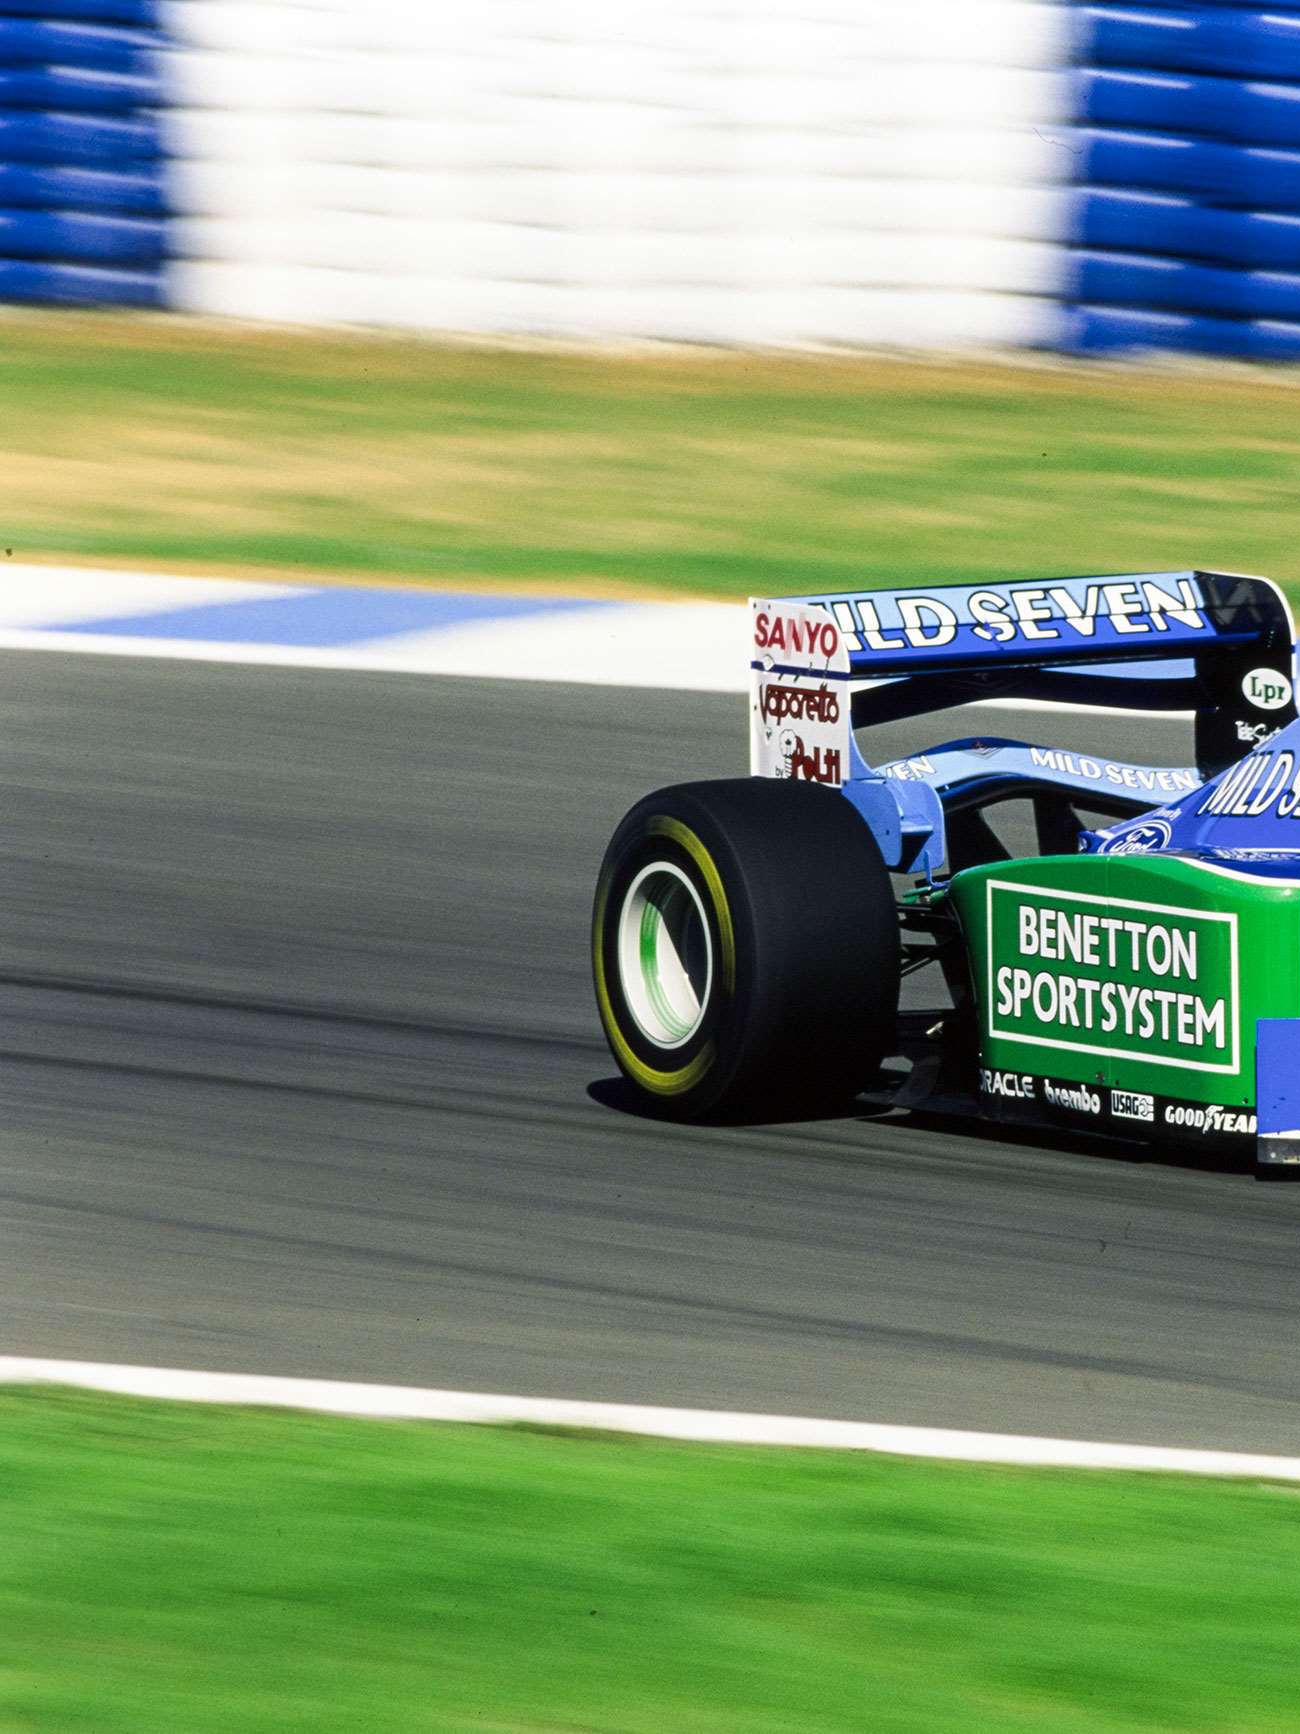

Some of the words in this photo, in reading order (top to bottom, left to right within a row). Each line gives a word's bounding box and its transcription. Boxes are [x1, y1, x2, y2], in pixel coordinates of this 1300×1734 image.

[754, 612, 838, 657] SANYO
[808, 596, 958, 652] ILD
[967, 577, 1204, 643] SEVEN
[1250, 676, 1286, 704] Lpr
[1030, 748, 1101, 779] MILD
[1105, 764, 1197, 791] SEVEN
[1197, 748, 1295, 818] MILD
[1018, 904, 1198, 981] BENETTON
[996, 965, 1226, 1049] SPORTSYSTEM
[1044, 1079, 1100, 1114] brembo
[1112, 1092, 1140, 1114] USAG
